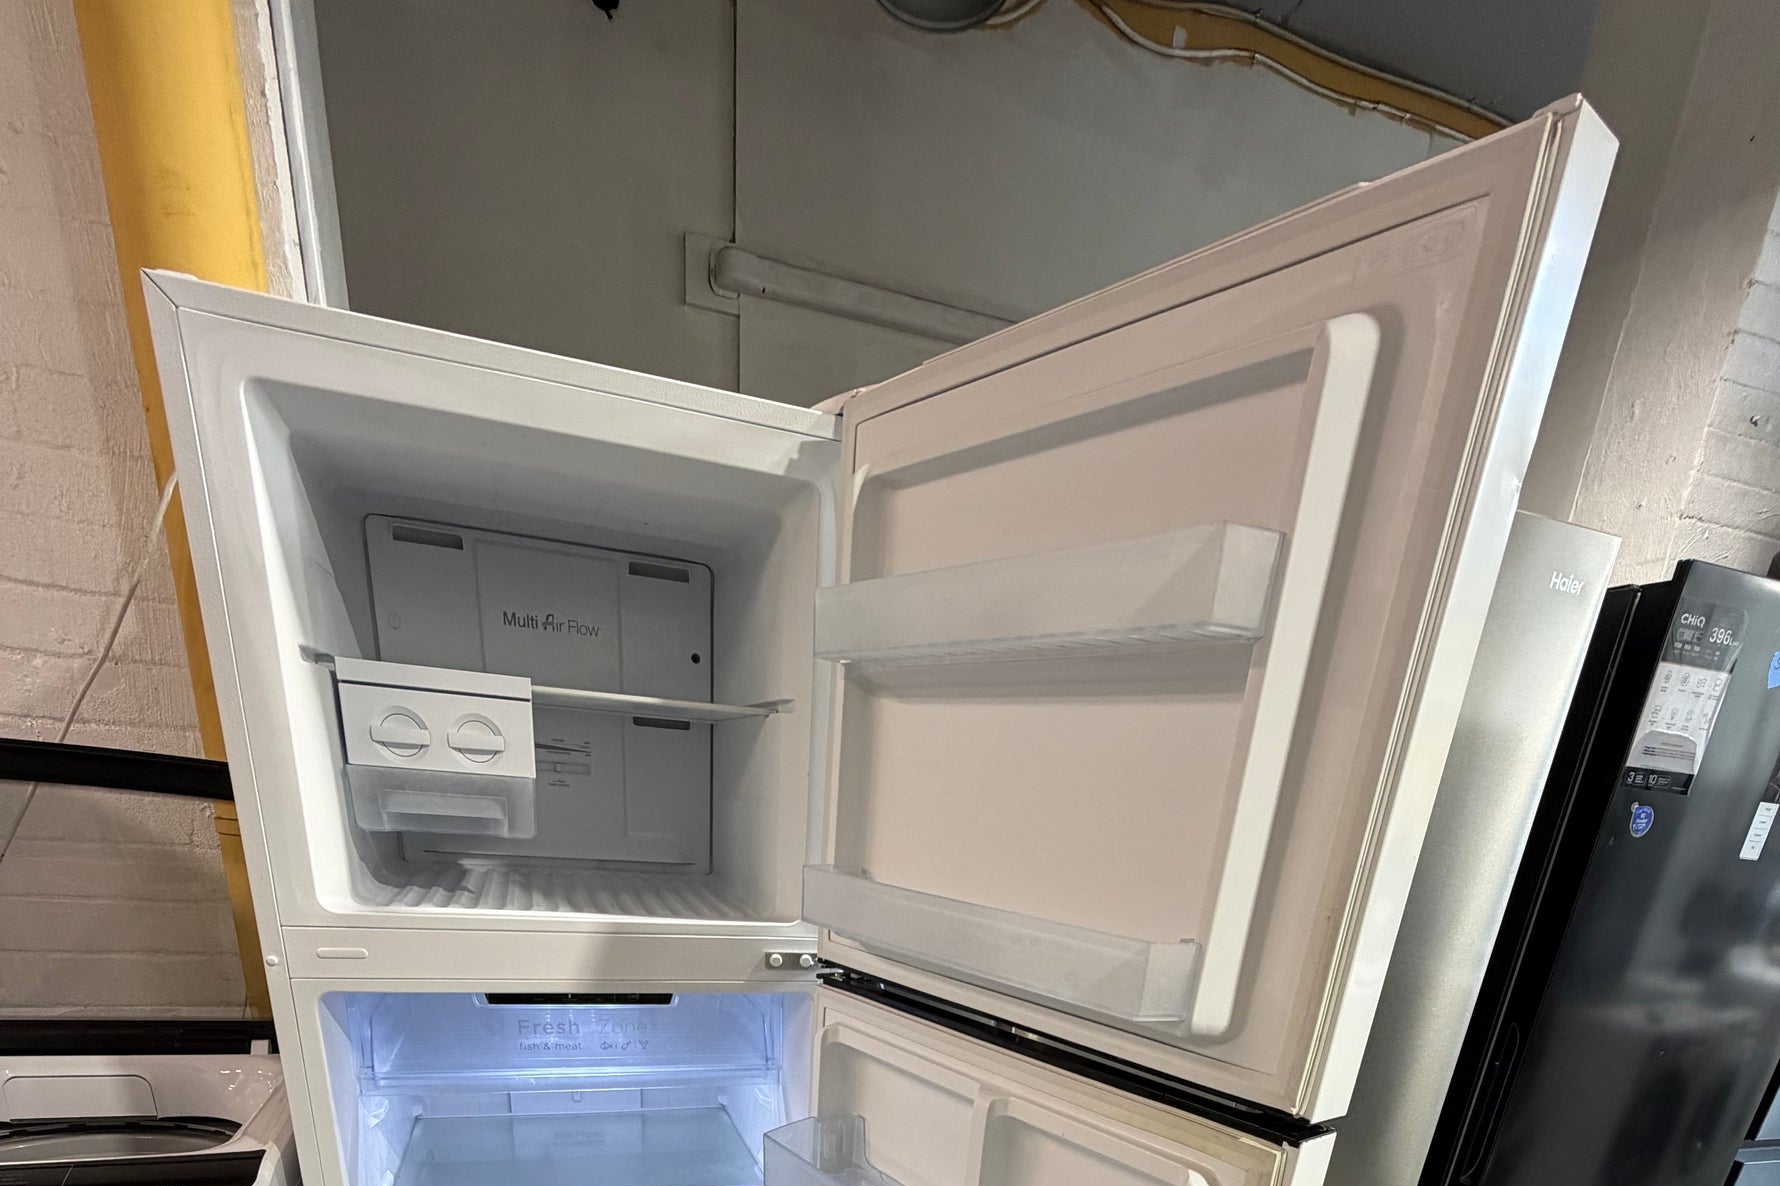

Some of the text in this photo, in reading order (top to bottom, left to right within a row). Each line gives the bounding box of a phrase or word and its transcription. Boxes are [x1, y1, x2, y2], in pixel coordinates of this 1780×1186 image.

[1550, 571, 1585, 595] Haier
[502, 610, 600, 637] Multi Air Flow
[1680, 613, 1706, 629] CHiQ
[517, 1018, 649, 1036] Fresh Zone
[519, 1042, 582, 1051] fish & meat
